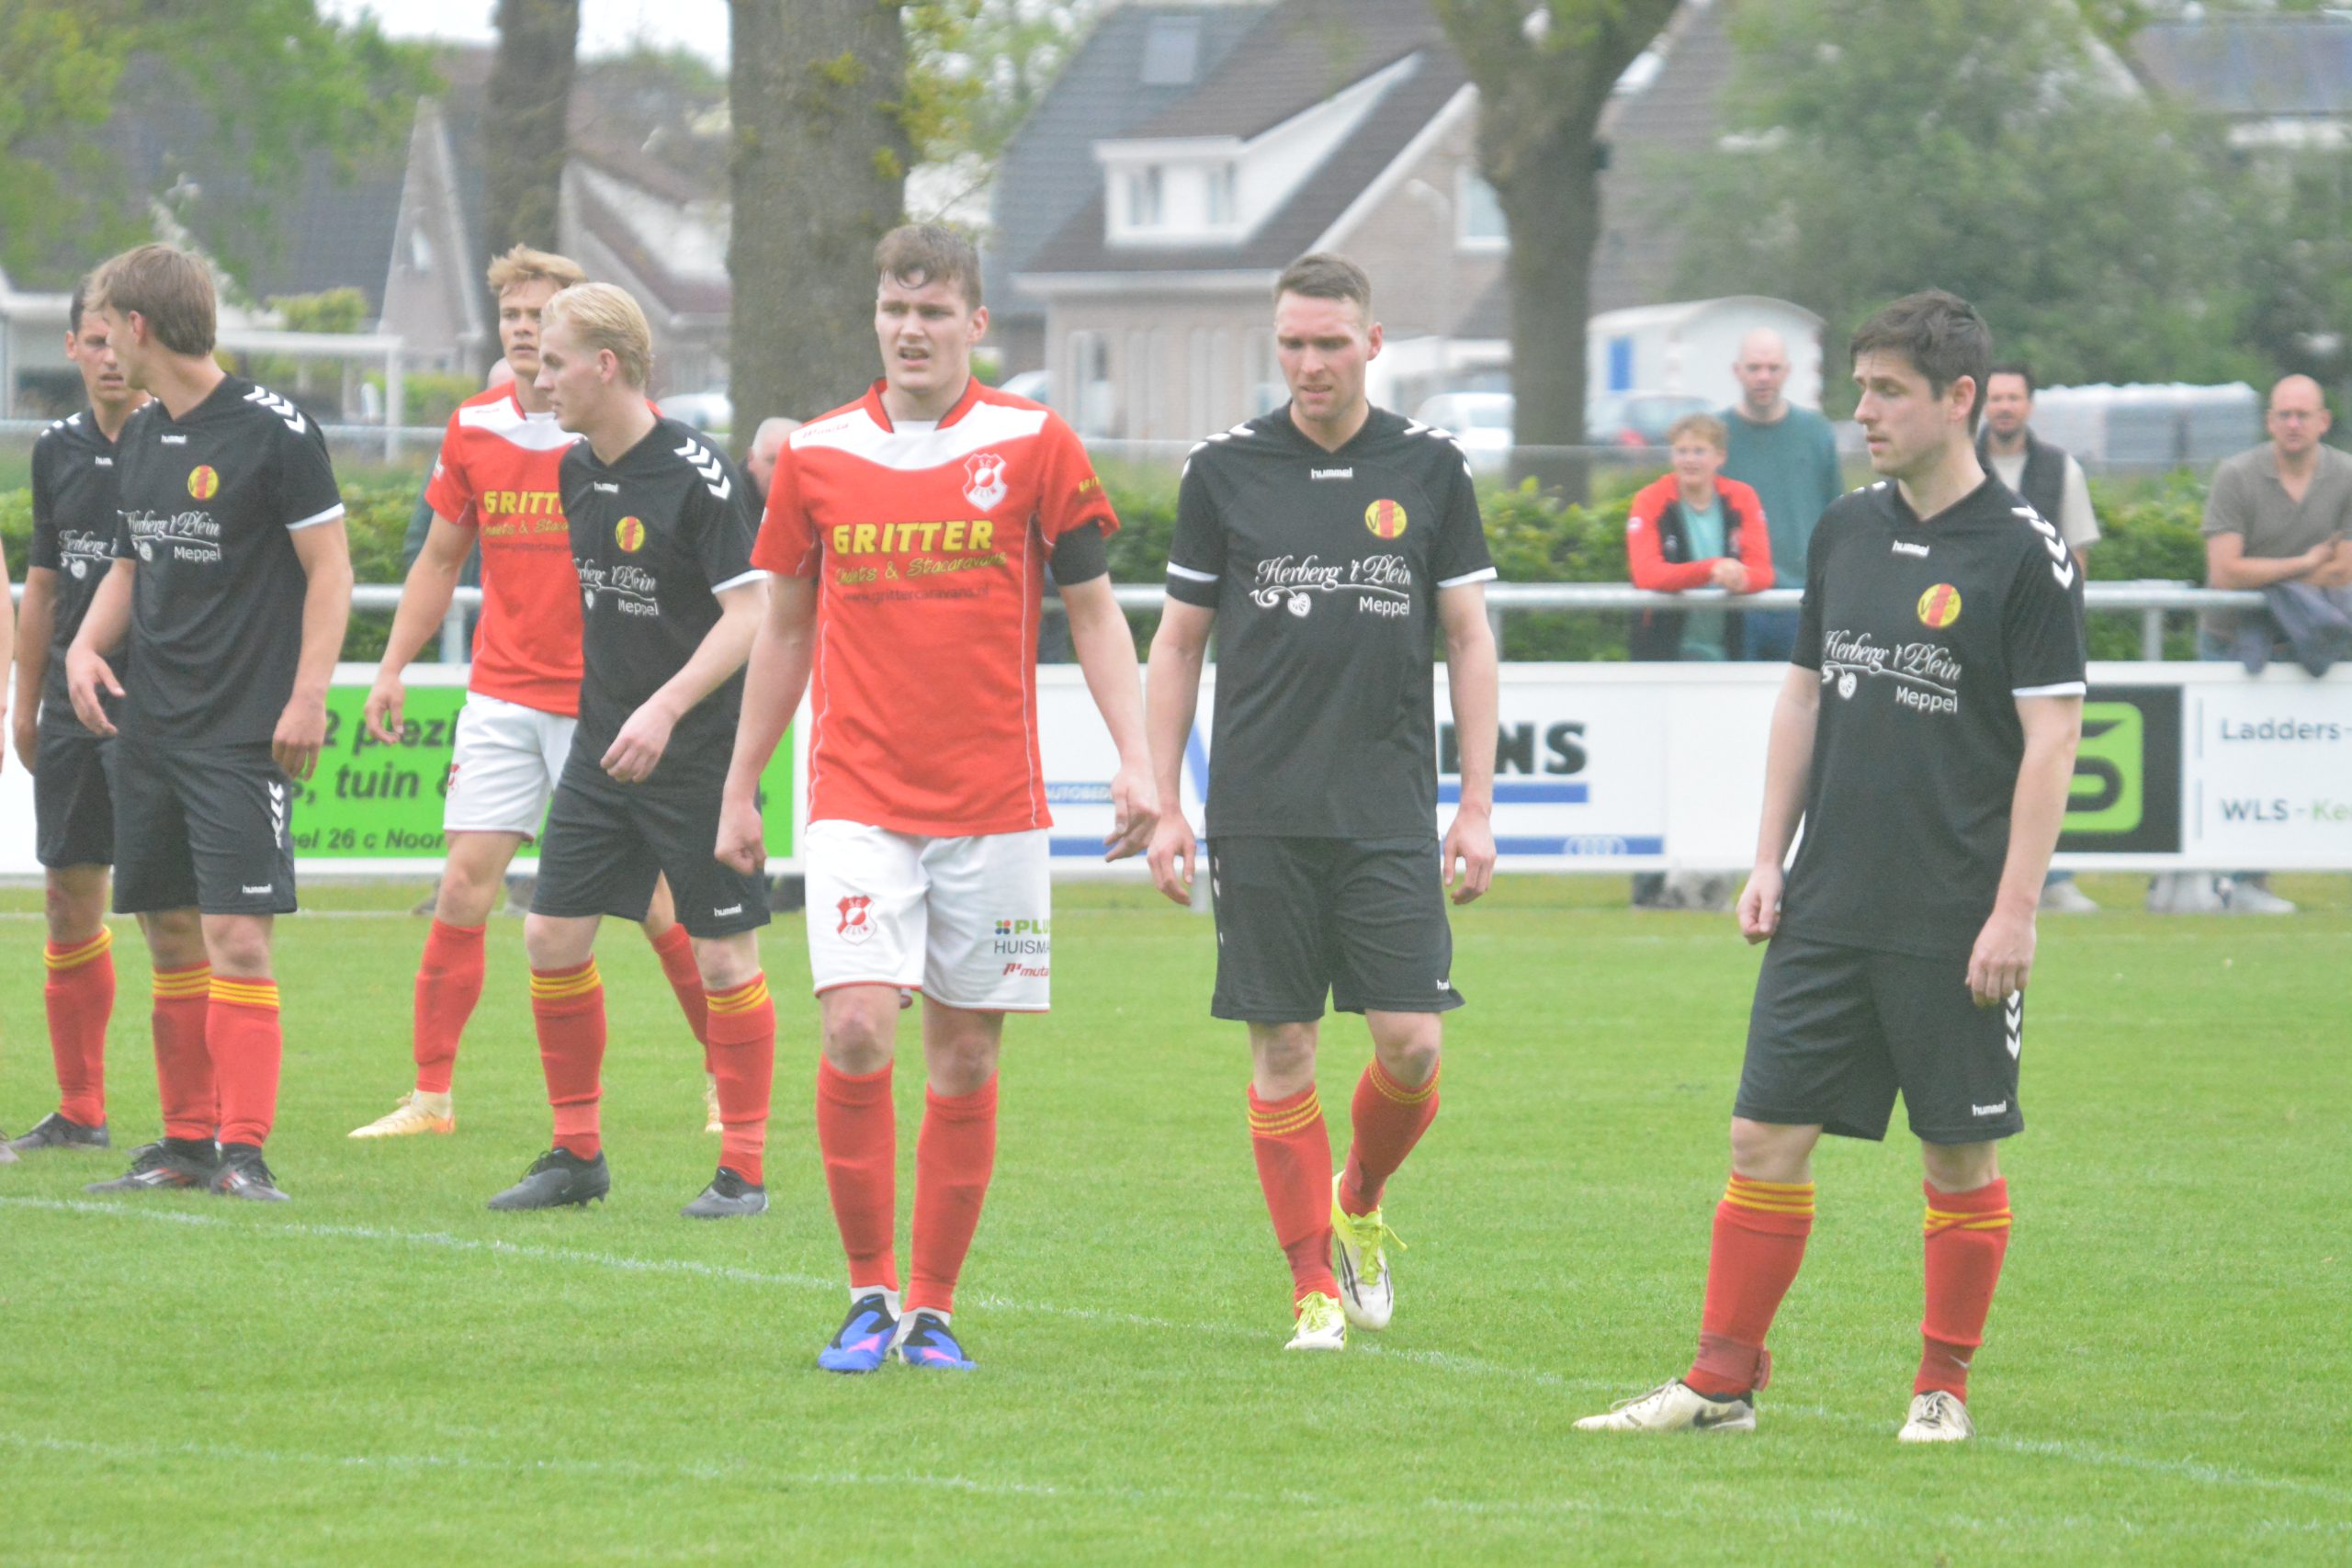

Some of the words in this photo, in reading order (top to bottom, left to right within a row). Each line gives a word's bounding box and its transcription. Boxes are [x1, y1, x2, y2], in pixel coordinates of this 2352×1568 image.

[1311, 467, 1353, 479] hummel
[176, 509, 221, 538] Plein
[833, 520, 994, 555] GRITTER
[174, 546, 222, 563] Meppel
[1892, 539, 1929, 558] hummel
[885, 560, 899, 581] &
[1255, 554, 1344, 591] Herberg
[1362, 553, 1412, 586] Plein
[617, 598, 660, 616] Meppel
[1359, 596, 1411, 618] Meppel
[1824, 629, 1890, 673] Herberg
[1903, 642, 1962, 682] Plein
[1895, 685, 1959, 715] Meppel
[2221, 717, 2341, 740] Ladders
[336, 761, 420, 799] tuin
[2221, 798, 2289, 820] WLS
[327, 829, 356, 850] 26
[242, 884, 272, 894] hummel
[713, 903, 741, 918] hummel
[1973, 1100, 2007, 1116] hummel
